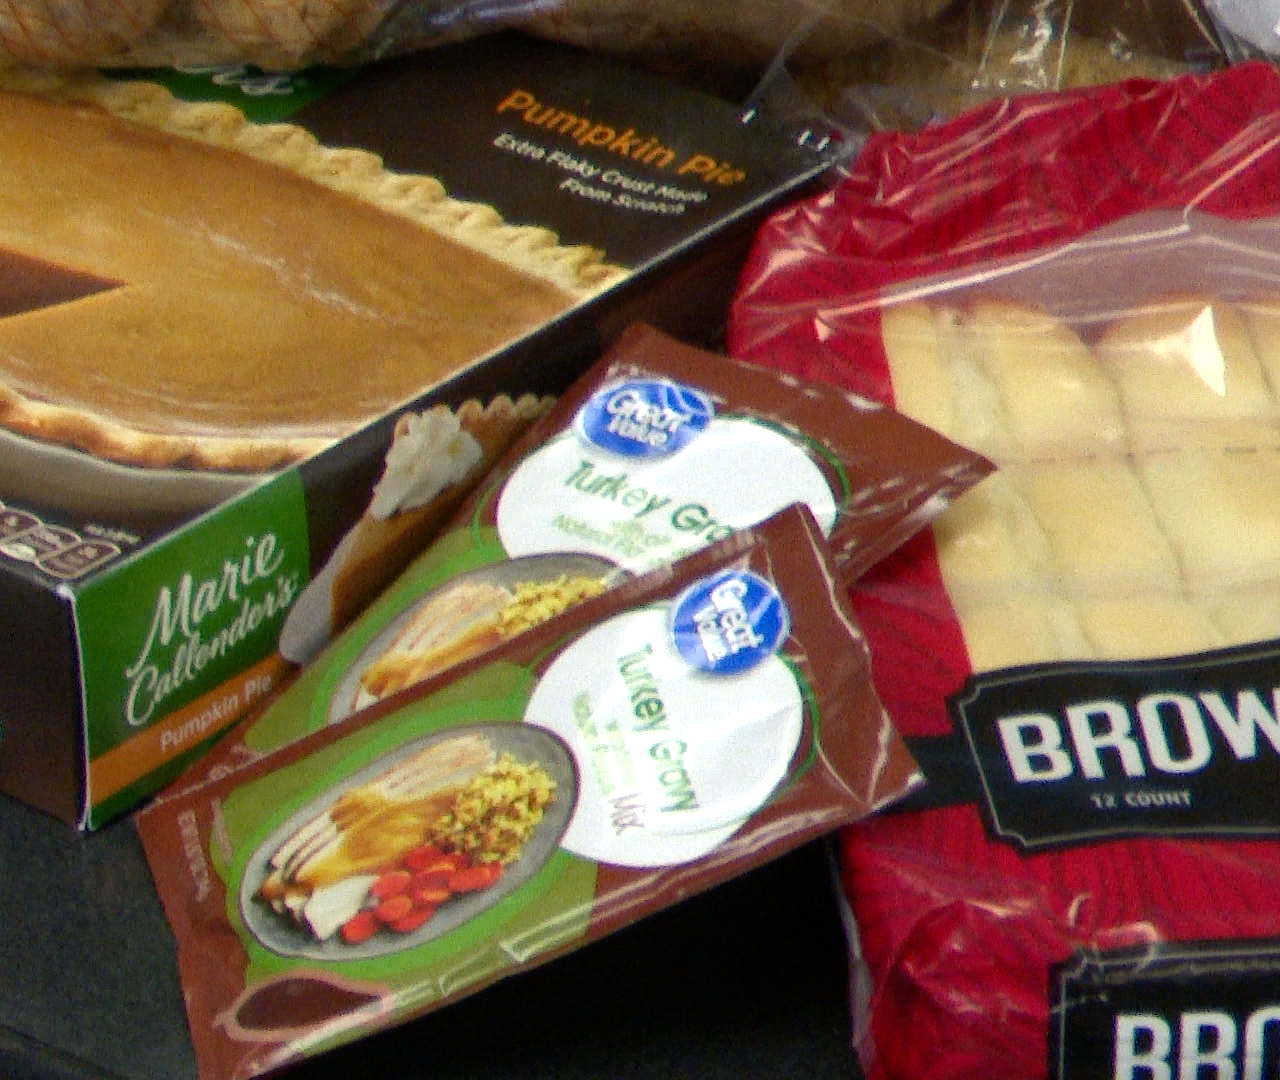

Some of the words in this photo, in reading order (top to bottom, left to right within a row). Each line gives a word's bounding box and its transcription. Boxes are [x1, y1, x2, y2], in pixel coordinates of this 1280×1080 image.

[493, 131, 547, 163] Extra
[545, 149, 597, 179] Flaky
[600, 167, 652, 195] Crust
[652, 182, 709, 205] Made
[497, 88, 678, 170] Pumpkin
[677, 152, 747, 186] Pie
[558, 177, 611, 204] From
[564, 459, 672, 519] Turkey
[670, 502, 734, 543] Gra
[125, 532, 286, 678] Marie
[125, 575, 299, 727] Callender's
[617, 641, 671, 734] Turkey
[160, 695, 239, 753] Pumpkin
[243, 675, 272, 705] Pie
[1090, 793, 1117, 810] 12
[1125, 790, 1191, 808] COUNT
